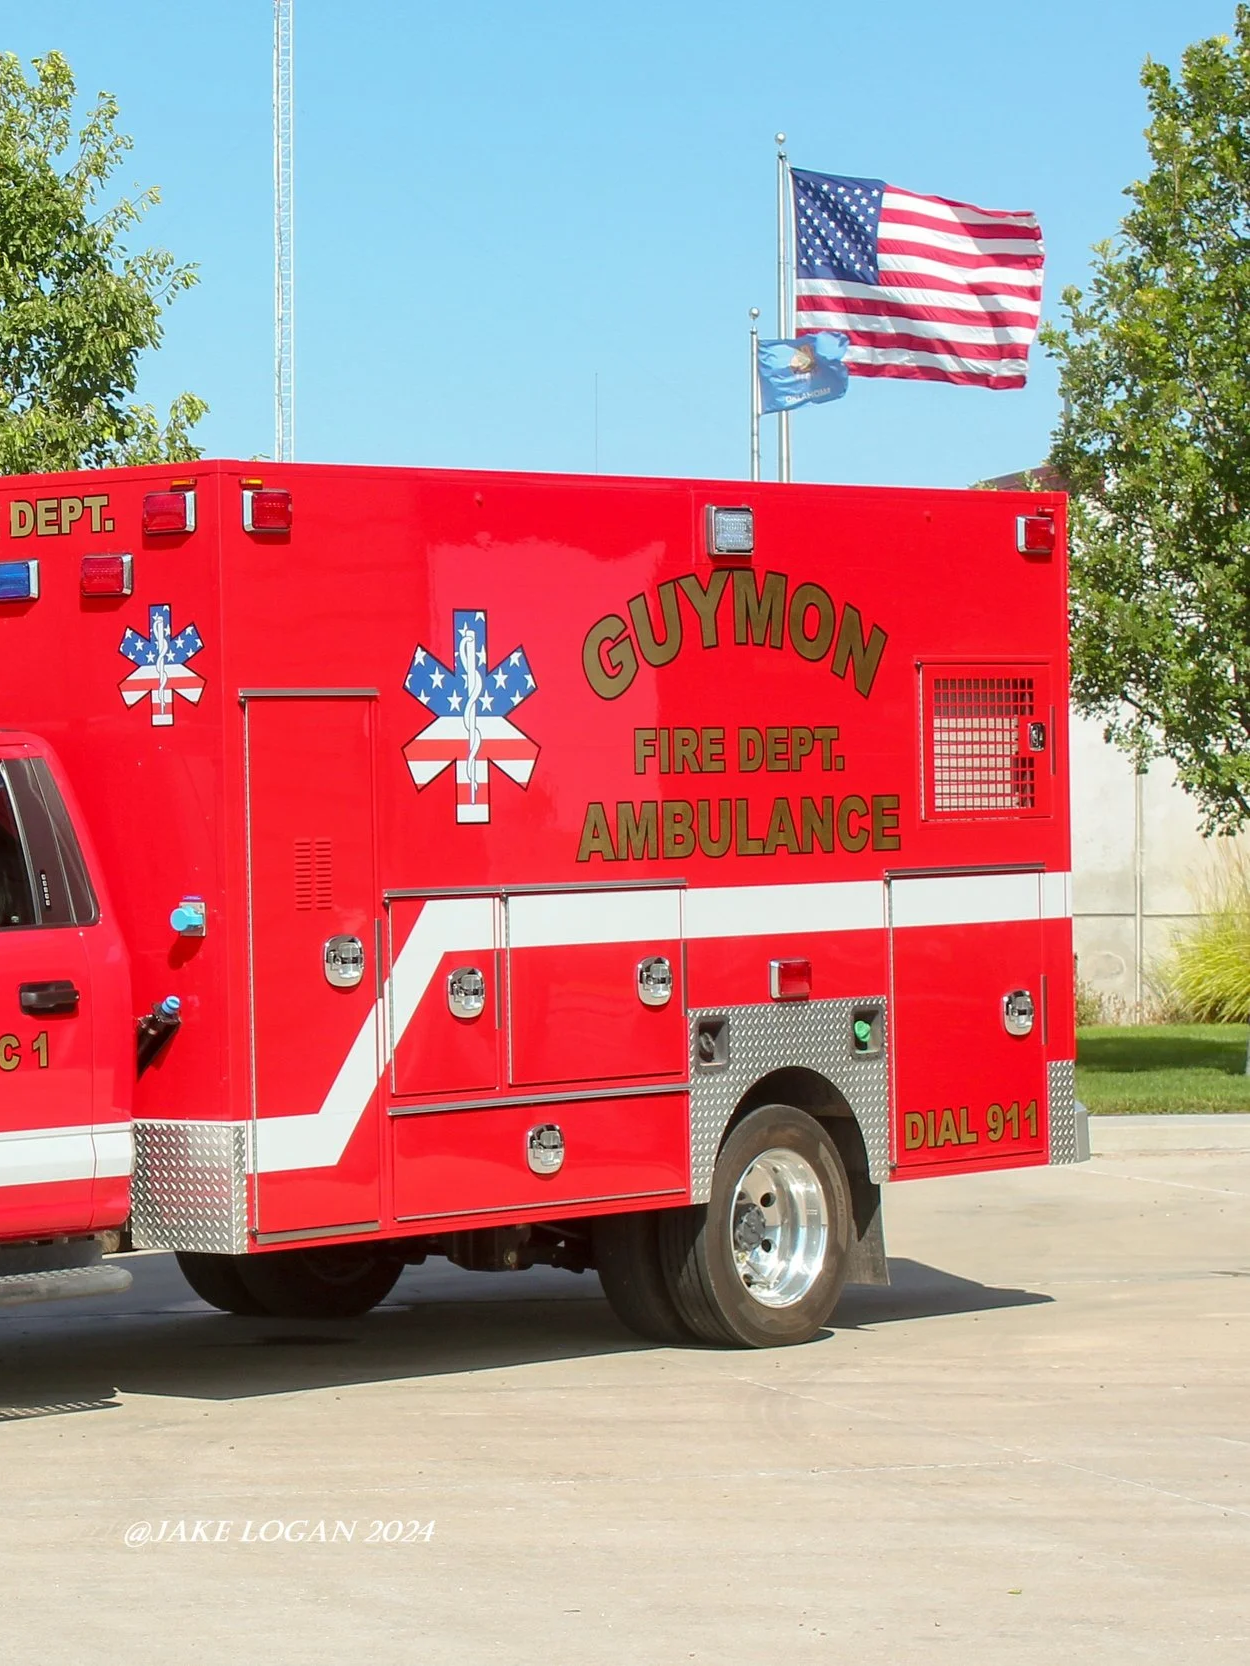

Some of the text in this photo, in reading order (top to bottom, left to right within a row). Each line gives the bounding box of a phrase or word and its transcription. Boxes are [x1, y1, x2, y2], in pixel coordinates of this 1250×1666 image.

[9, 494, 116, 539] DEPT.
[581, 567, 888, 700] GUYMON
[633, 725, 846, 775] FIRE DEPT.
[575, 794, 902, 863] AMBULANCE
[32, 1032, 50, 1069] 1
[904, 1099, 1039, 1151] DIAL 911
